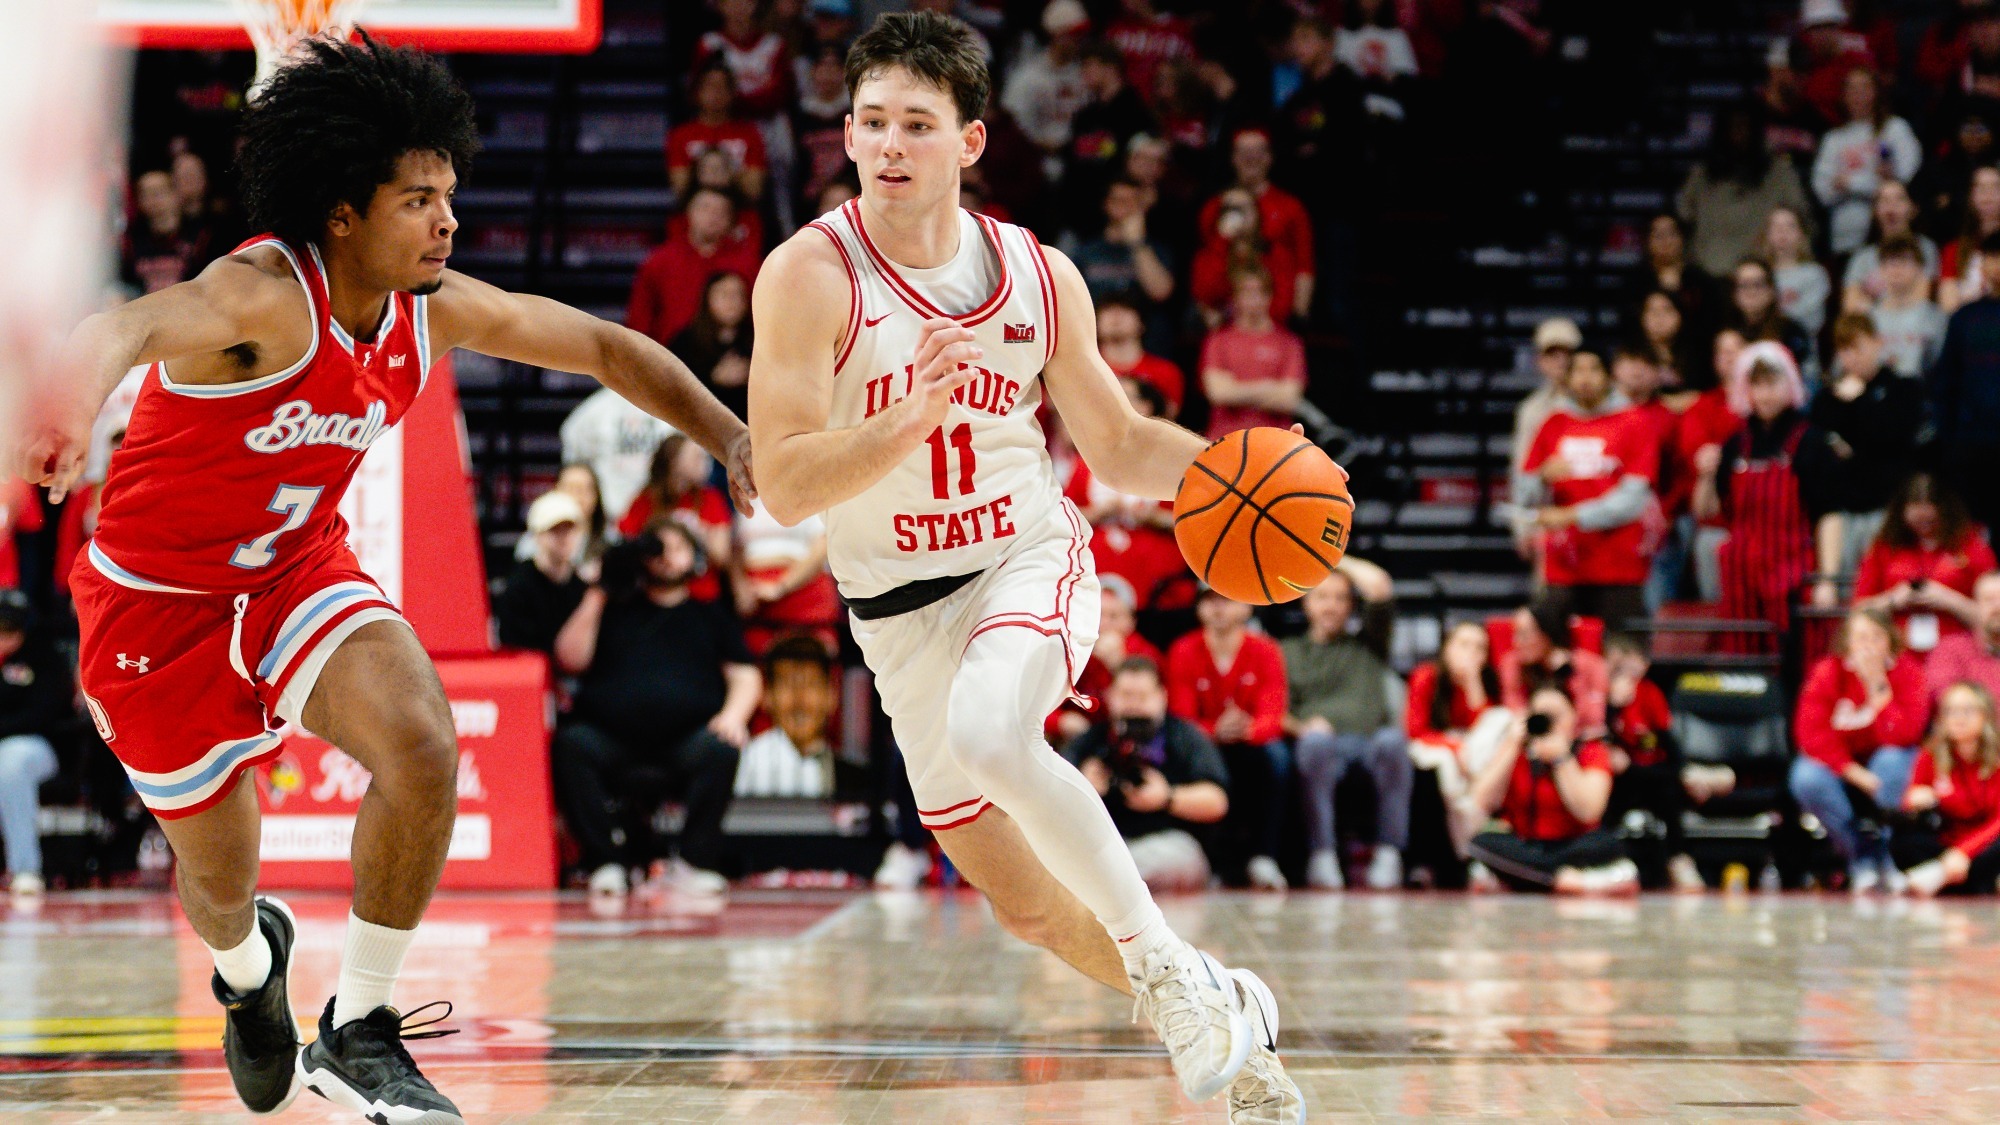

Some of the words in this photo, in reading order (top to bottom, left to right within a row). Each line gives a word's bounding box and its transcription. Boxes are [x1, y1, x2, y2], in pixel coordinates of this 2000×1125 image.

[864, 362, 1020, 420] ILOIS
[924, 422, 977, 500] 11
[227, 482, 326, 570] 7
[893, 494, 1016, 552] STATE
